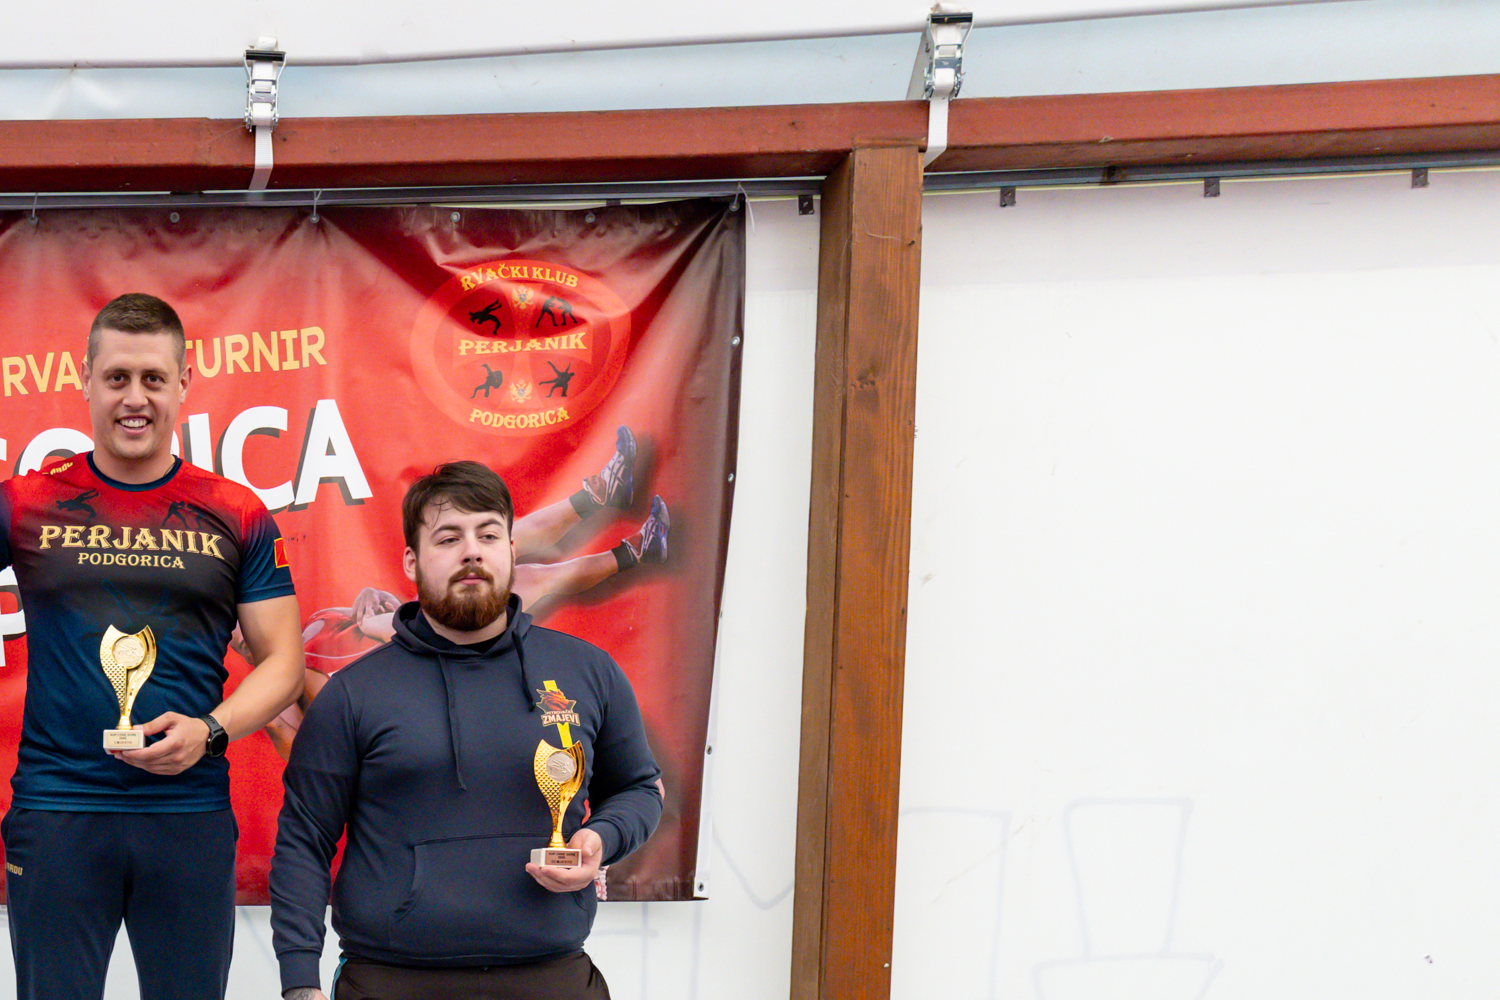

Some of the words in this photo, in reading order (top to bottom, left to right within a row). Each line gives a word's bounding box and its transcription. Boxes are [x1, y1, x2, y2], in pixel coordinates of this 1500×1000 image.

[460, 263, 528, 291] RVAČKI
[532, 266, 579, 288] KLUB
[458, 331, 588, 356] PERJANIK
[468, 406, 571, 429] PODGORICA
[38, 525, 225, 561] PERJANIK
[77, 552, 186, 570] PODGORICA
[542, 713, 579, 724] ZMAJEVI
